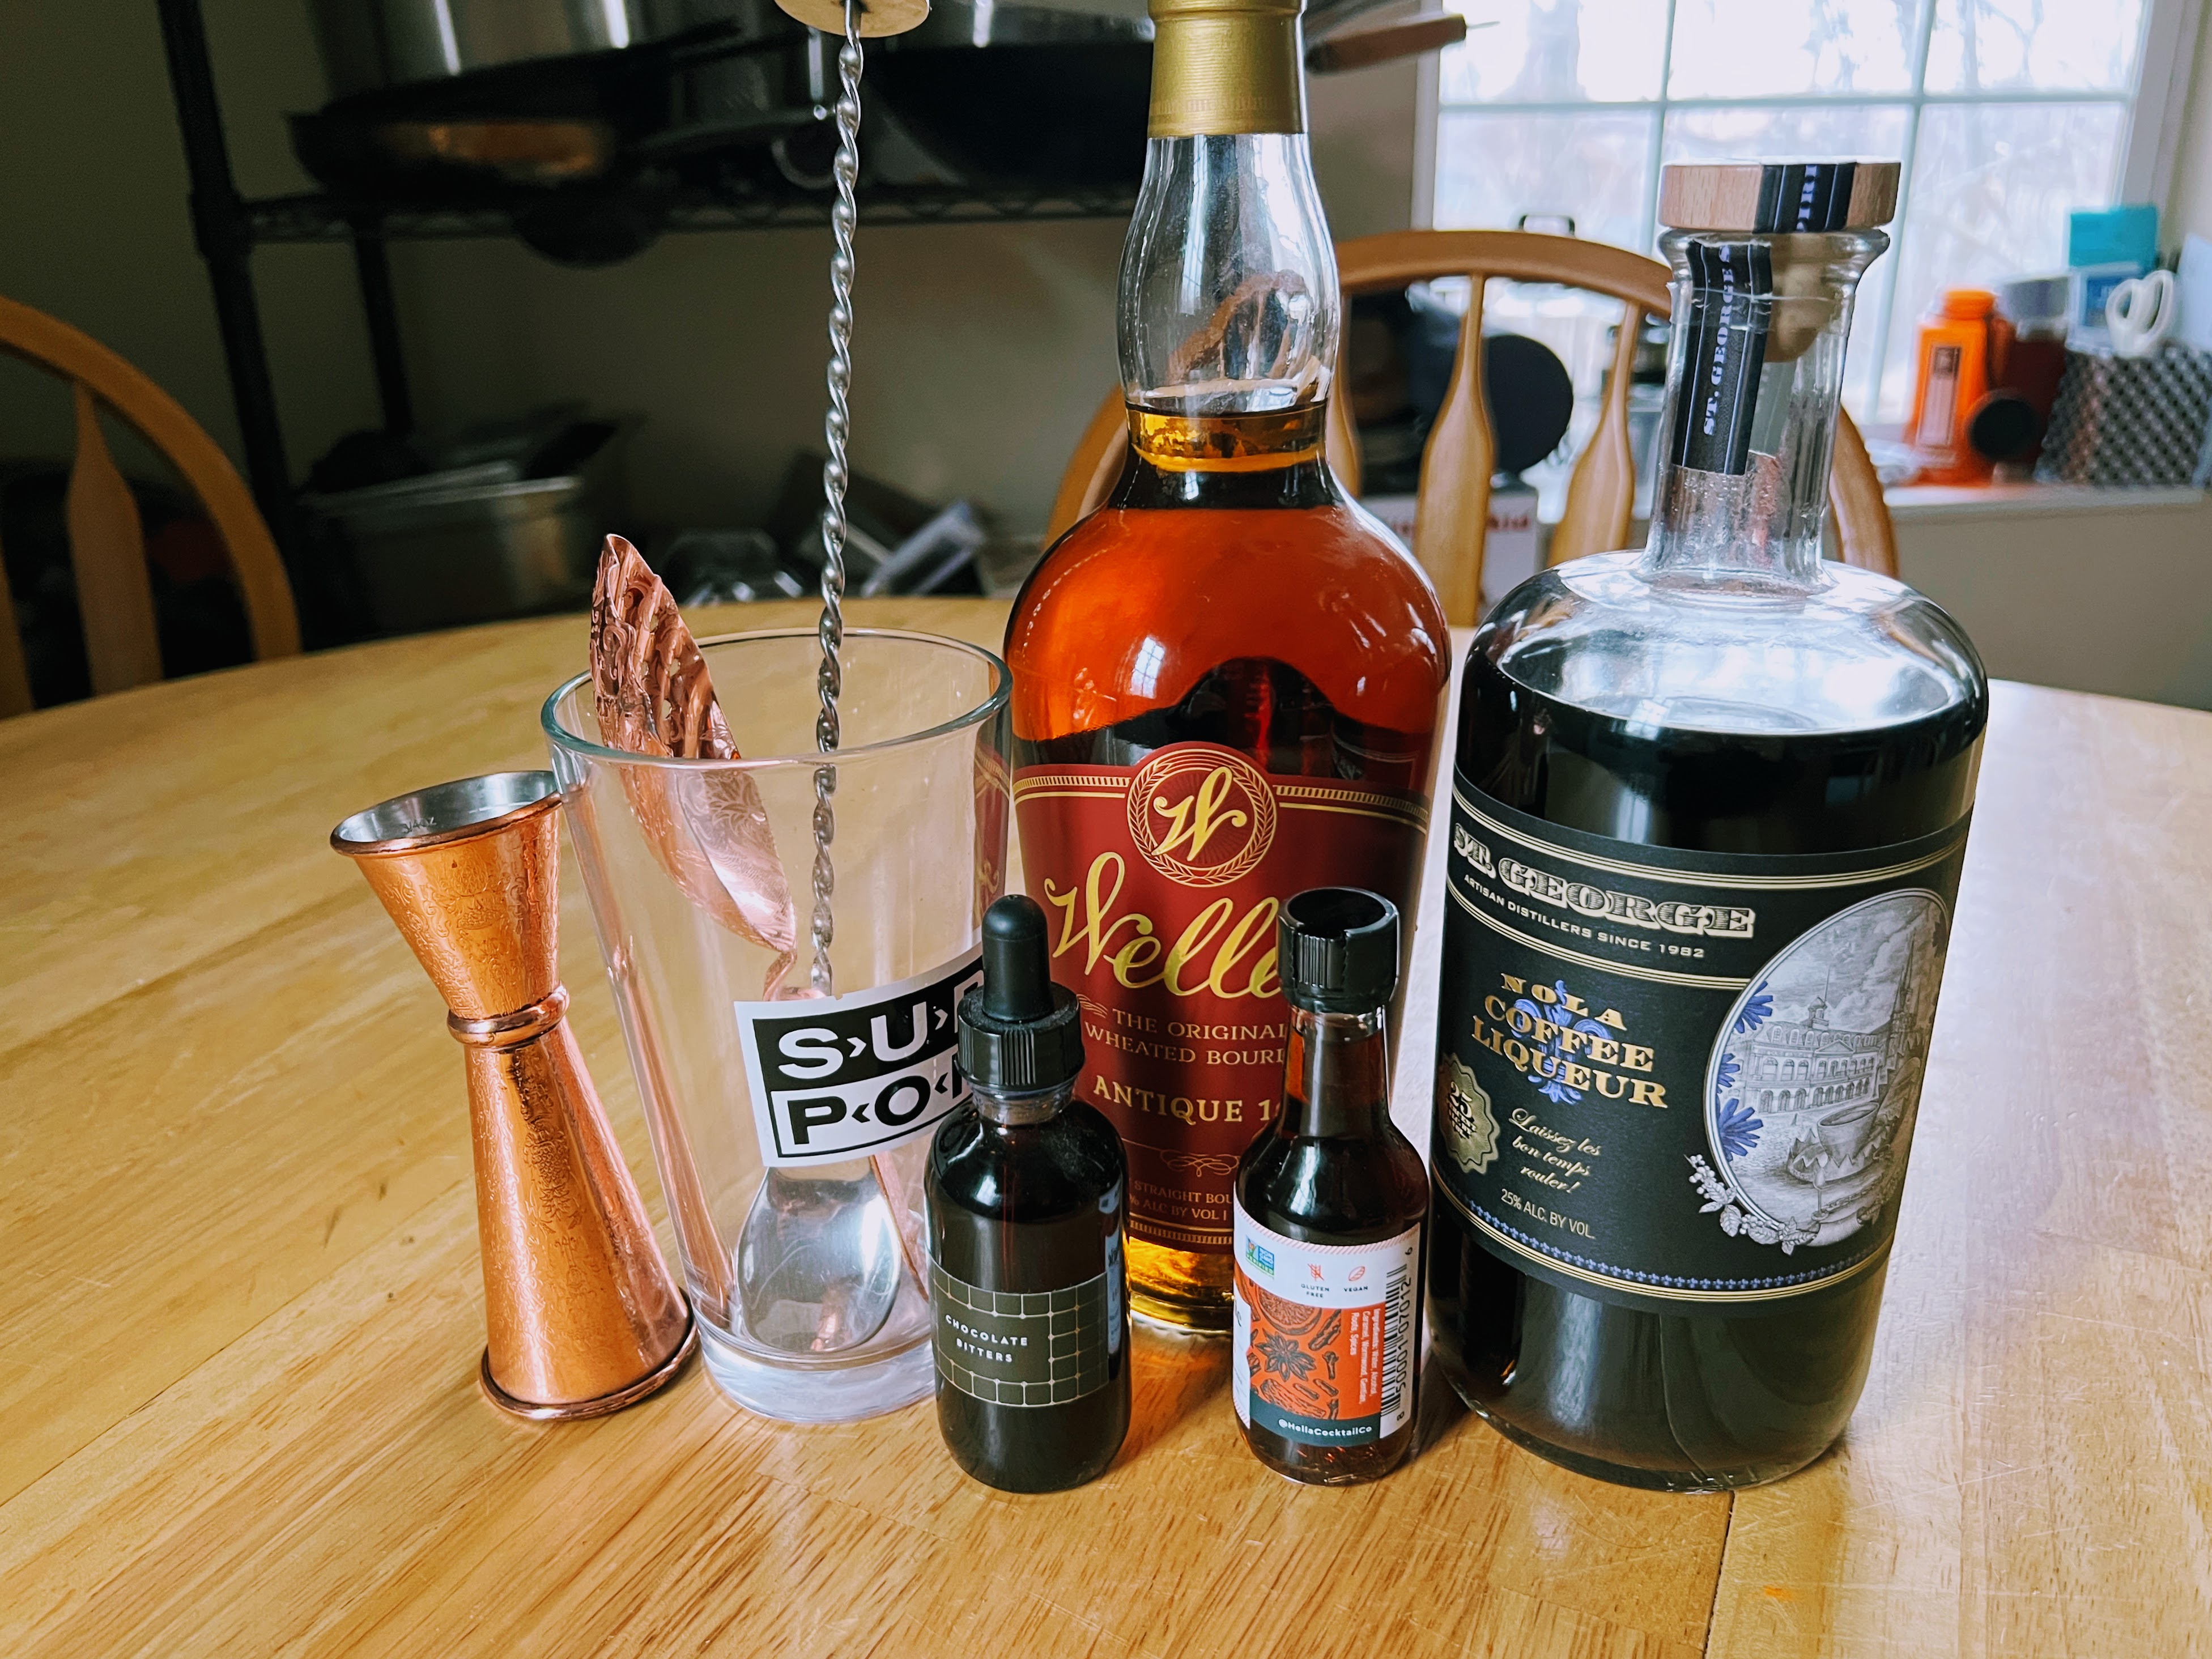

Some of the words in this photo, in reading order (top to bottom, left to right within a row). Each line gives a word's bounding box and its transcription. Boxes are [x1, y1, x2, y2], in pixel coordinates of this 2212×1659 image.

[1711, 268, 1733, 385] GEORGE
[1464, 874, 1505, 907] ARTISAN
[1508, 896, 1592, 938] DISTILLERS
[1598, 932, 1651, 951] SINCE
[1660, 944, 1704, 958] 1982
[1498, 857, 1756, 938] GEORGE
[1112, 1008, 1157, 1033] THE
[1500, 973, 1627, 1031] NOLA
[1084, 1022, 1196, 1063] WHEATED
[1484, 995, 1654, 1072] COFFEE
[1471, 1015, 1668, 1109] LIQUEUR
[1094, 1075, 1243, 1125] ANTIQUE
[1450, 1081, 1473, 1118] 25
[1509, 1107, 1576, 1154] Laissez
[1577, 1136, 1601, 1156] les
[1512, 1135, 1541, 1158] bon
[1542, 1151, 1590, 1179] temps
[1134, 1180, 1202, 1202] STRAIGHT
[1143, 1199, 1168, 1213] ALC
[1171, 1206, 1188, 1216] BY
[1192, 1208, 1220, 1220] VOL
[1501, 1188, 1522, 1210] 25%
[1523, 1203, 1547, 1223] ALC.
[1550, 1213, 1566, 1228] BY
[1569, 1219, 1596, 1240] VOL.
[1301, 1283, 1329, 1292] GLUTEN
[945, 1315, 1028, 1346] CHOCOLATE
[956, 1338, 1013, 1363] BITTERS
[1278, 1418, 1372, 1437] @HellaCocktailCo
